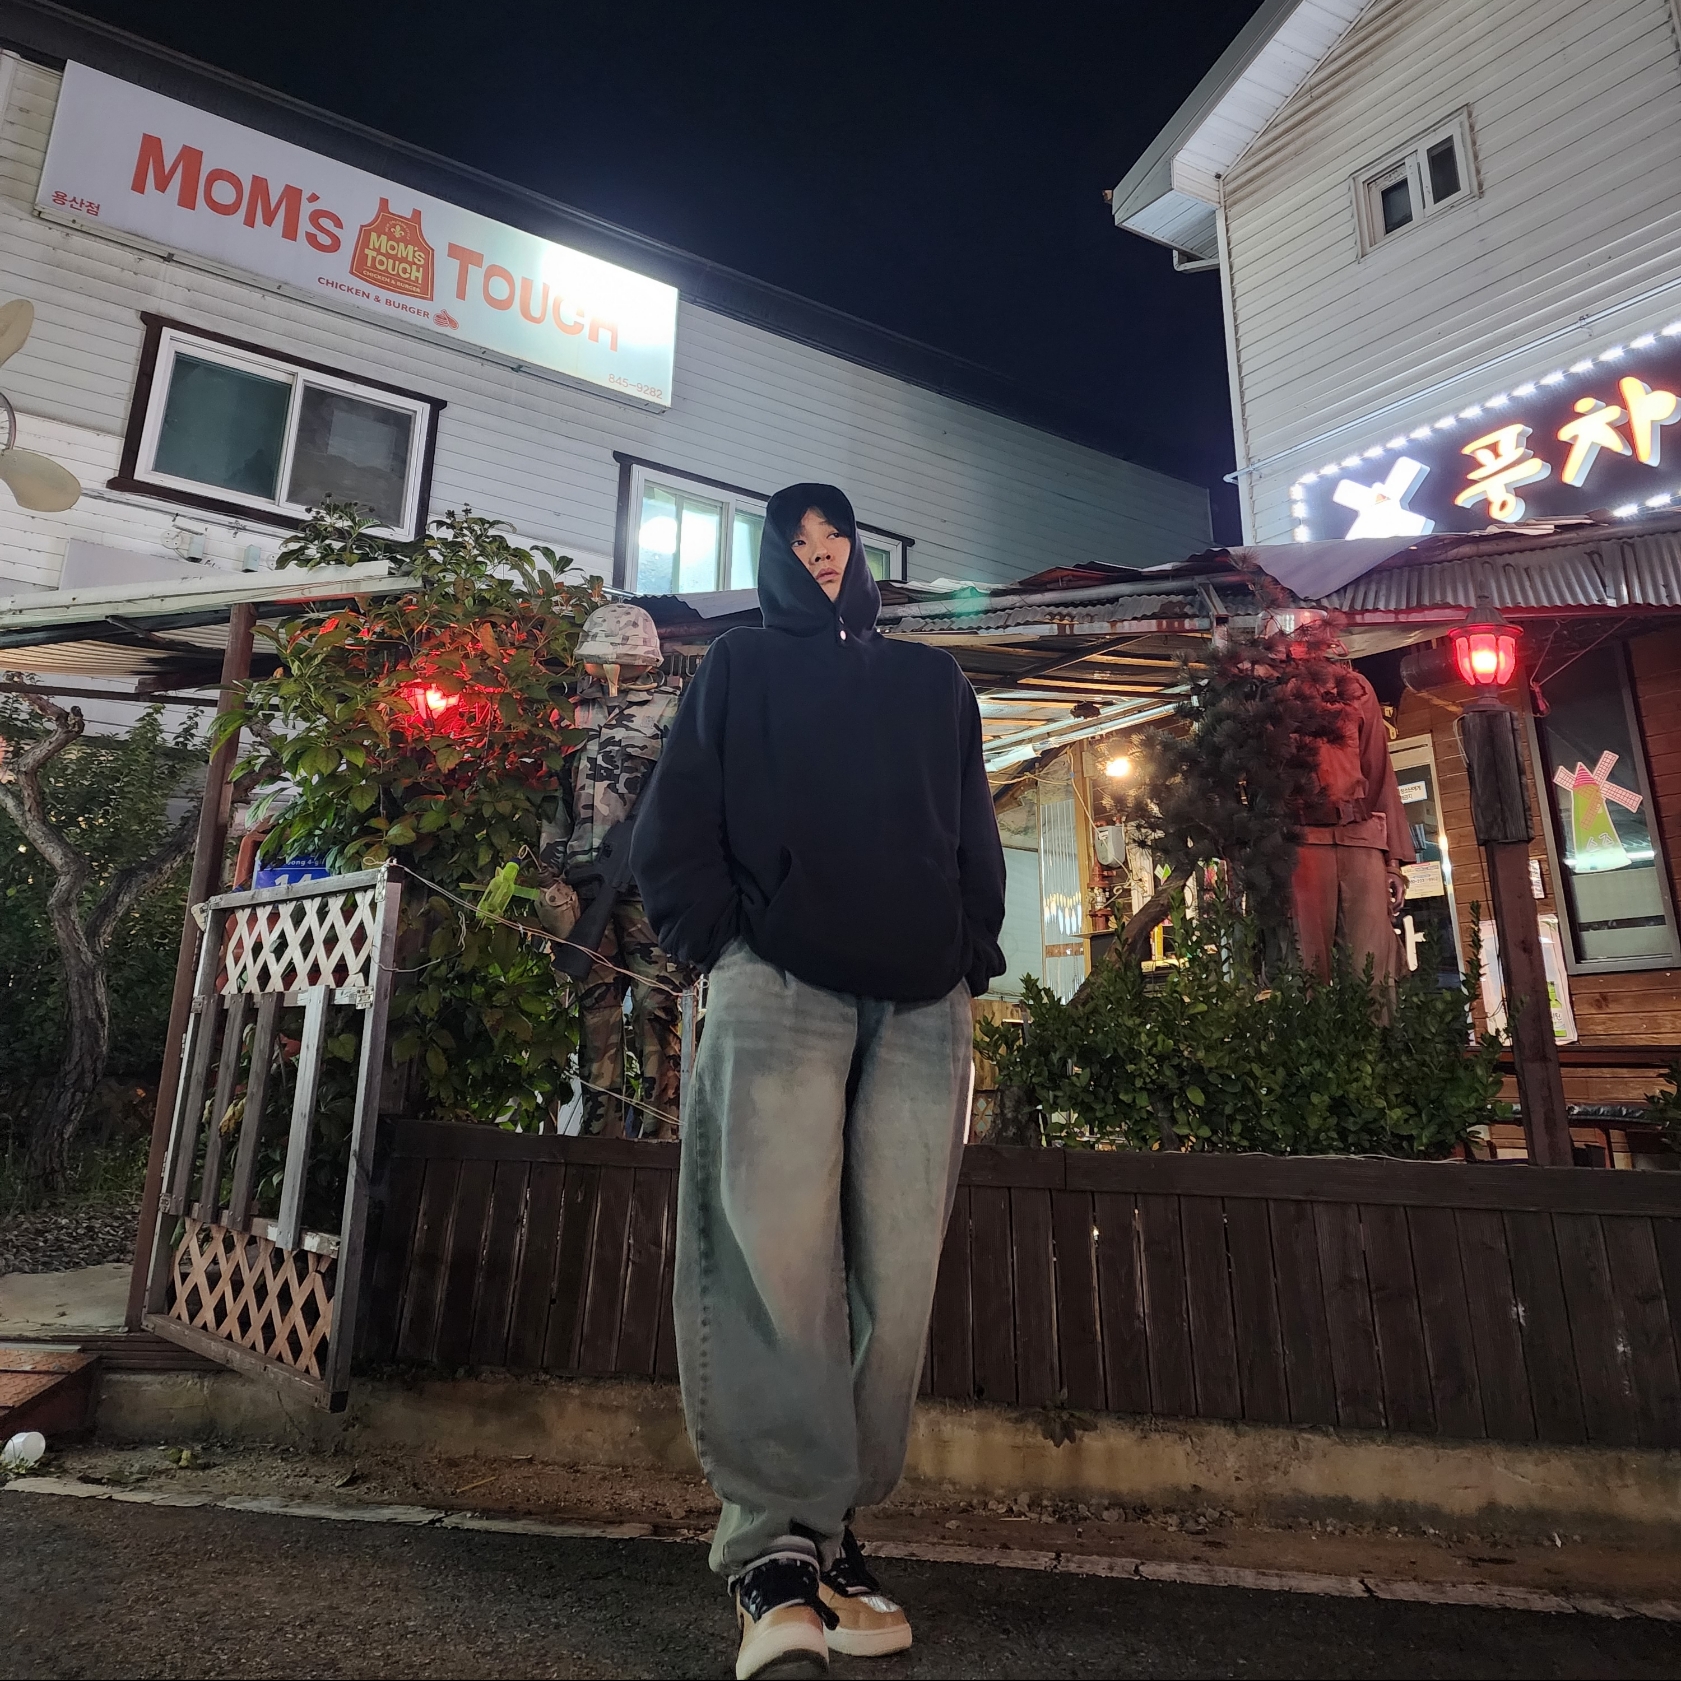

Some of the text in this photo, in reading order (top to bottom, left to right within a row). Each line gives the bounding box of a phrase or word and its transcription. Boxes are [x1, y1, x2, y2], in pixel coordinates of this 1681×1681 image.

[51, 190, 101, 217] 용산점
[362, 270, 390, 282] CHICKEN
[364, 248, 423, 284] TOUCH
[317, 276, 430, 319] CHICKEN & BURGER
[447, 241, 618, 352] TOUCH
[608, 373, 664, 400] 845-9282
[1454, 376, 1681, 524] 풍차
